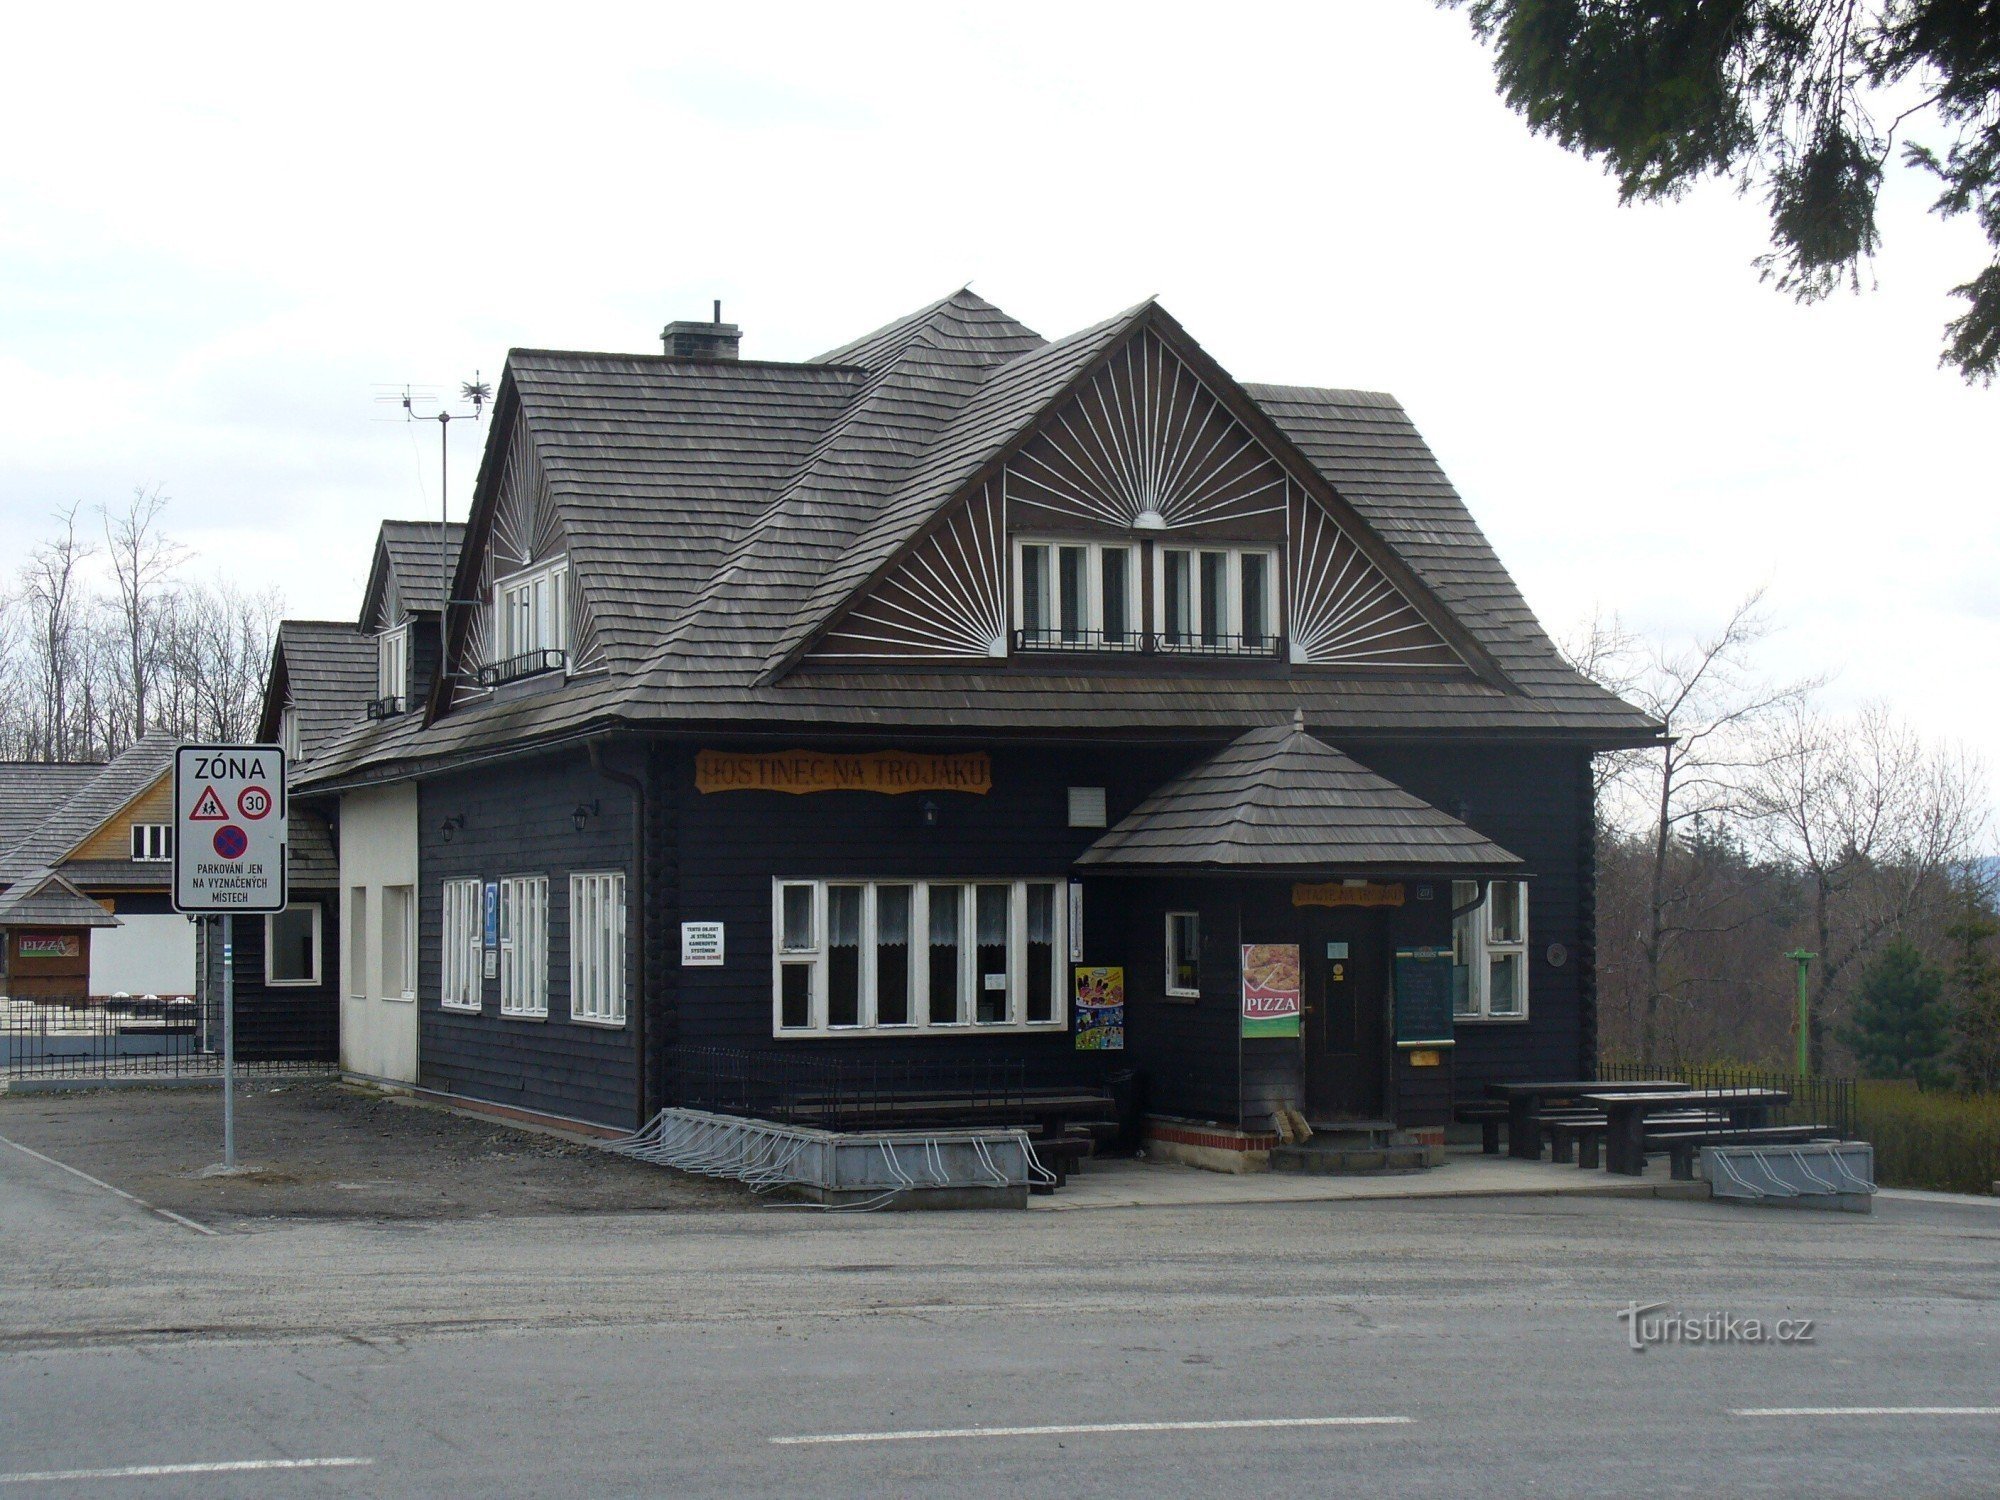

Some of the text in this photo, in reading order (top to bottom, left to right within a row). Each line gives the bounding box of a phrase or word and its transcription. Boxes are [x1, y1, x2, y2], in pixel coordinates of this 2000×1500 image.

[194, 753, 266, 780] ZÓNA
[702, 759, 824, 785] HOSTINEC
[832, 759, 864, 785] NA
[245, 796, 264, 811] 30
[197, 861, 263, 874] PARKOVÁNÍ JEN
[192, 875, 268, 888] NA VYZNAČENÝCH
[212, 889, 248, 902] MÍSTECH
[487, 891, 494, 927] P
[23, 940, 66, 951] PIZZA
[1246, 997, 1296, 1012] PIZZA
